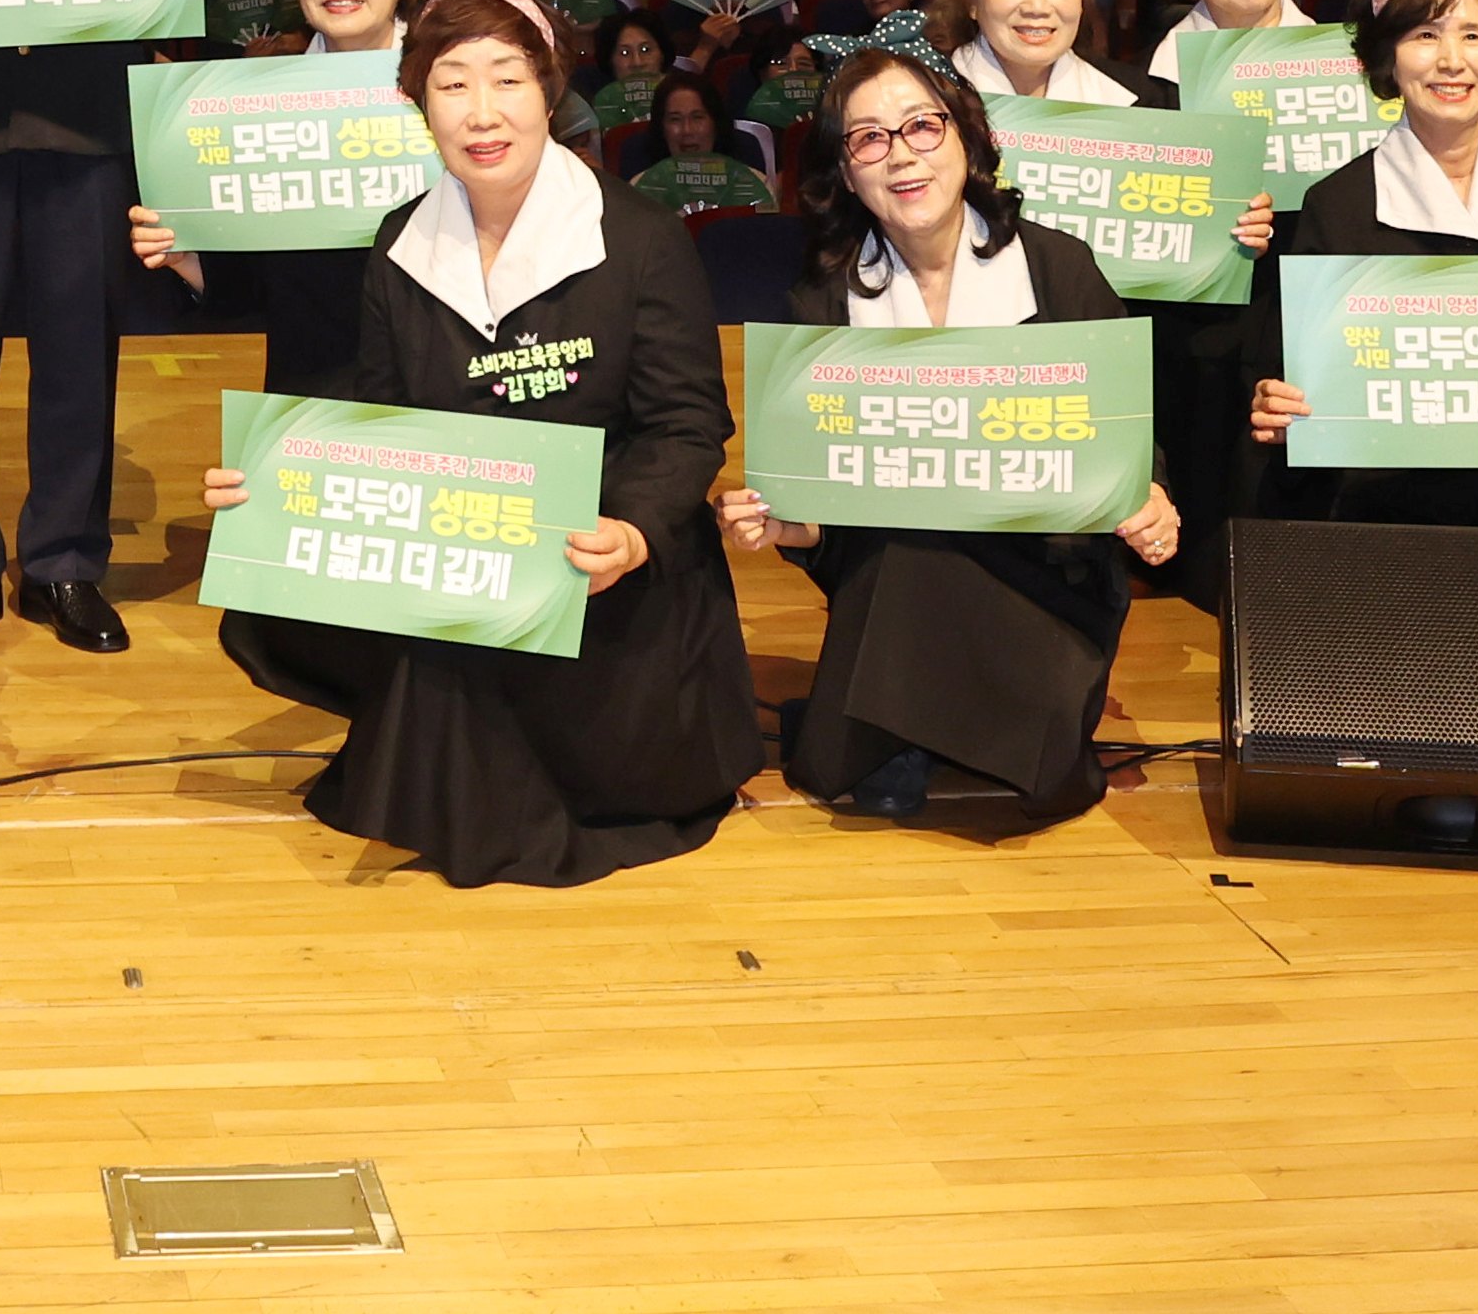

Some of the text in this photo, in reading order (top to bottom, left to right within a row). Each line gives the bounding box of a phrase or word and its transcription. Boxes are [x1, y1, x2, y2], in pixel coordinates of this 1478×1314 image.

[1275, 83, 1368, 125] 모두의
[232, 119, 331, 163] 모두의
[1291, 131, 1354, 173] 넓고
[210, 164, 426, 214] 더 넓고 더 깊게
[1014, 160, 1215, 218] 모두의 성평등,
[1093, 216, 1194, 264] 더 깊게
[1347, 296, 1391, 315] 2026
[1393, 295, 1443, 315] 양산시
[467, 337, 595, 379] 소비자교육중앙회
[811, 363, 1088, 386] 2026 양산시 양성평등주간 기념행사
[501, 367, 568, 404] 김경희
[1366, 379, 1403, 425] 더
[858, 394, 1097, 442] 모두의 성평등,
[283, 437, 535, 483] 2026 양산시 양성평등주간 기념행사
[825, 444, 1074, 494] 더 넓고 더 깊게
[320, 474, 538, 546] 모두의 성평등,
[286, 527, 513, 602] 더 넓고 더 깊게
